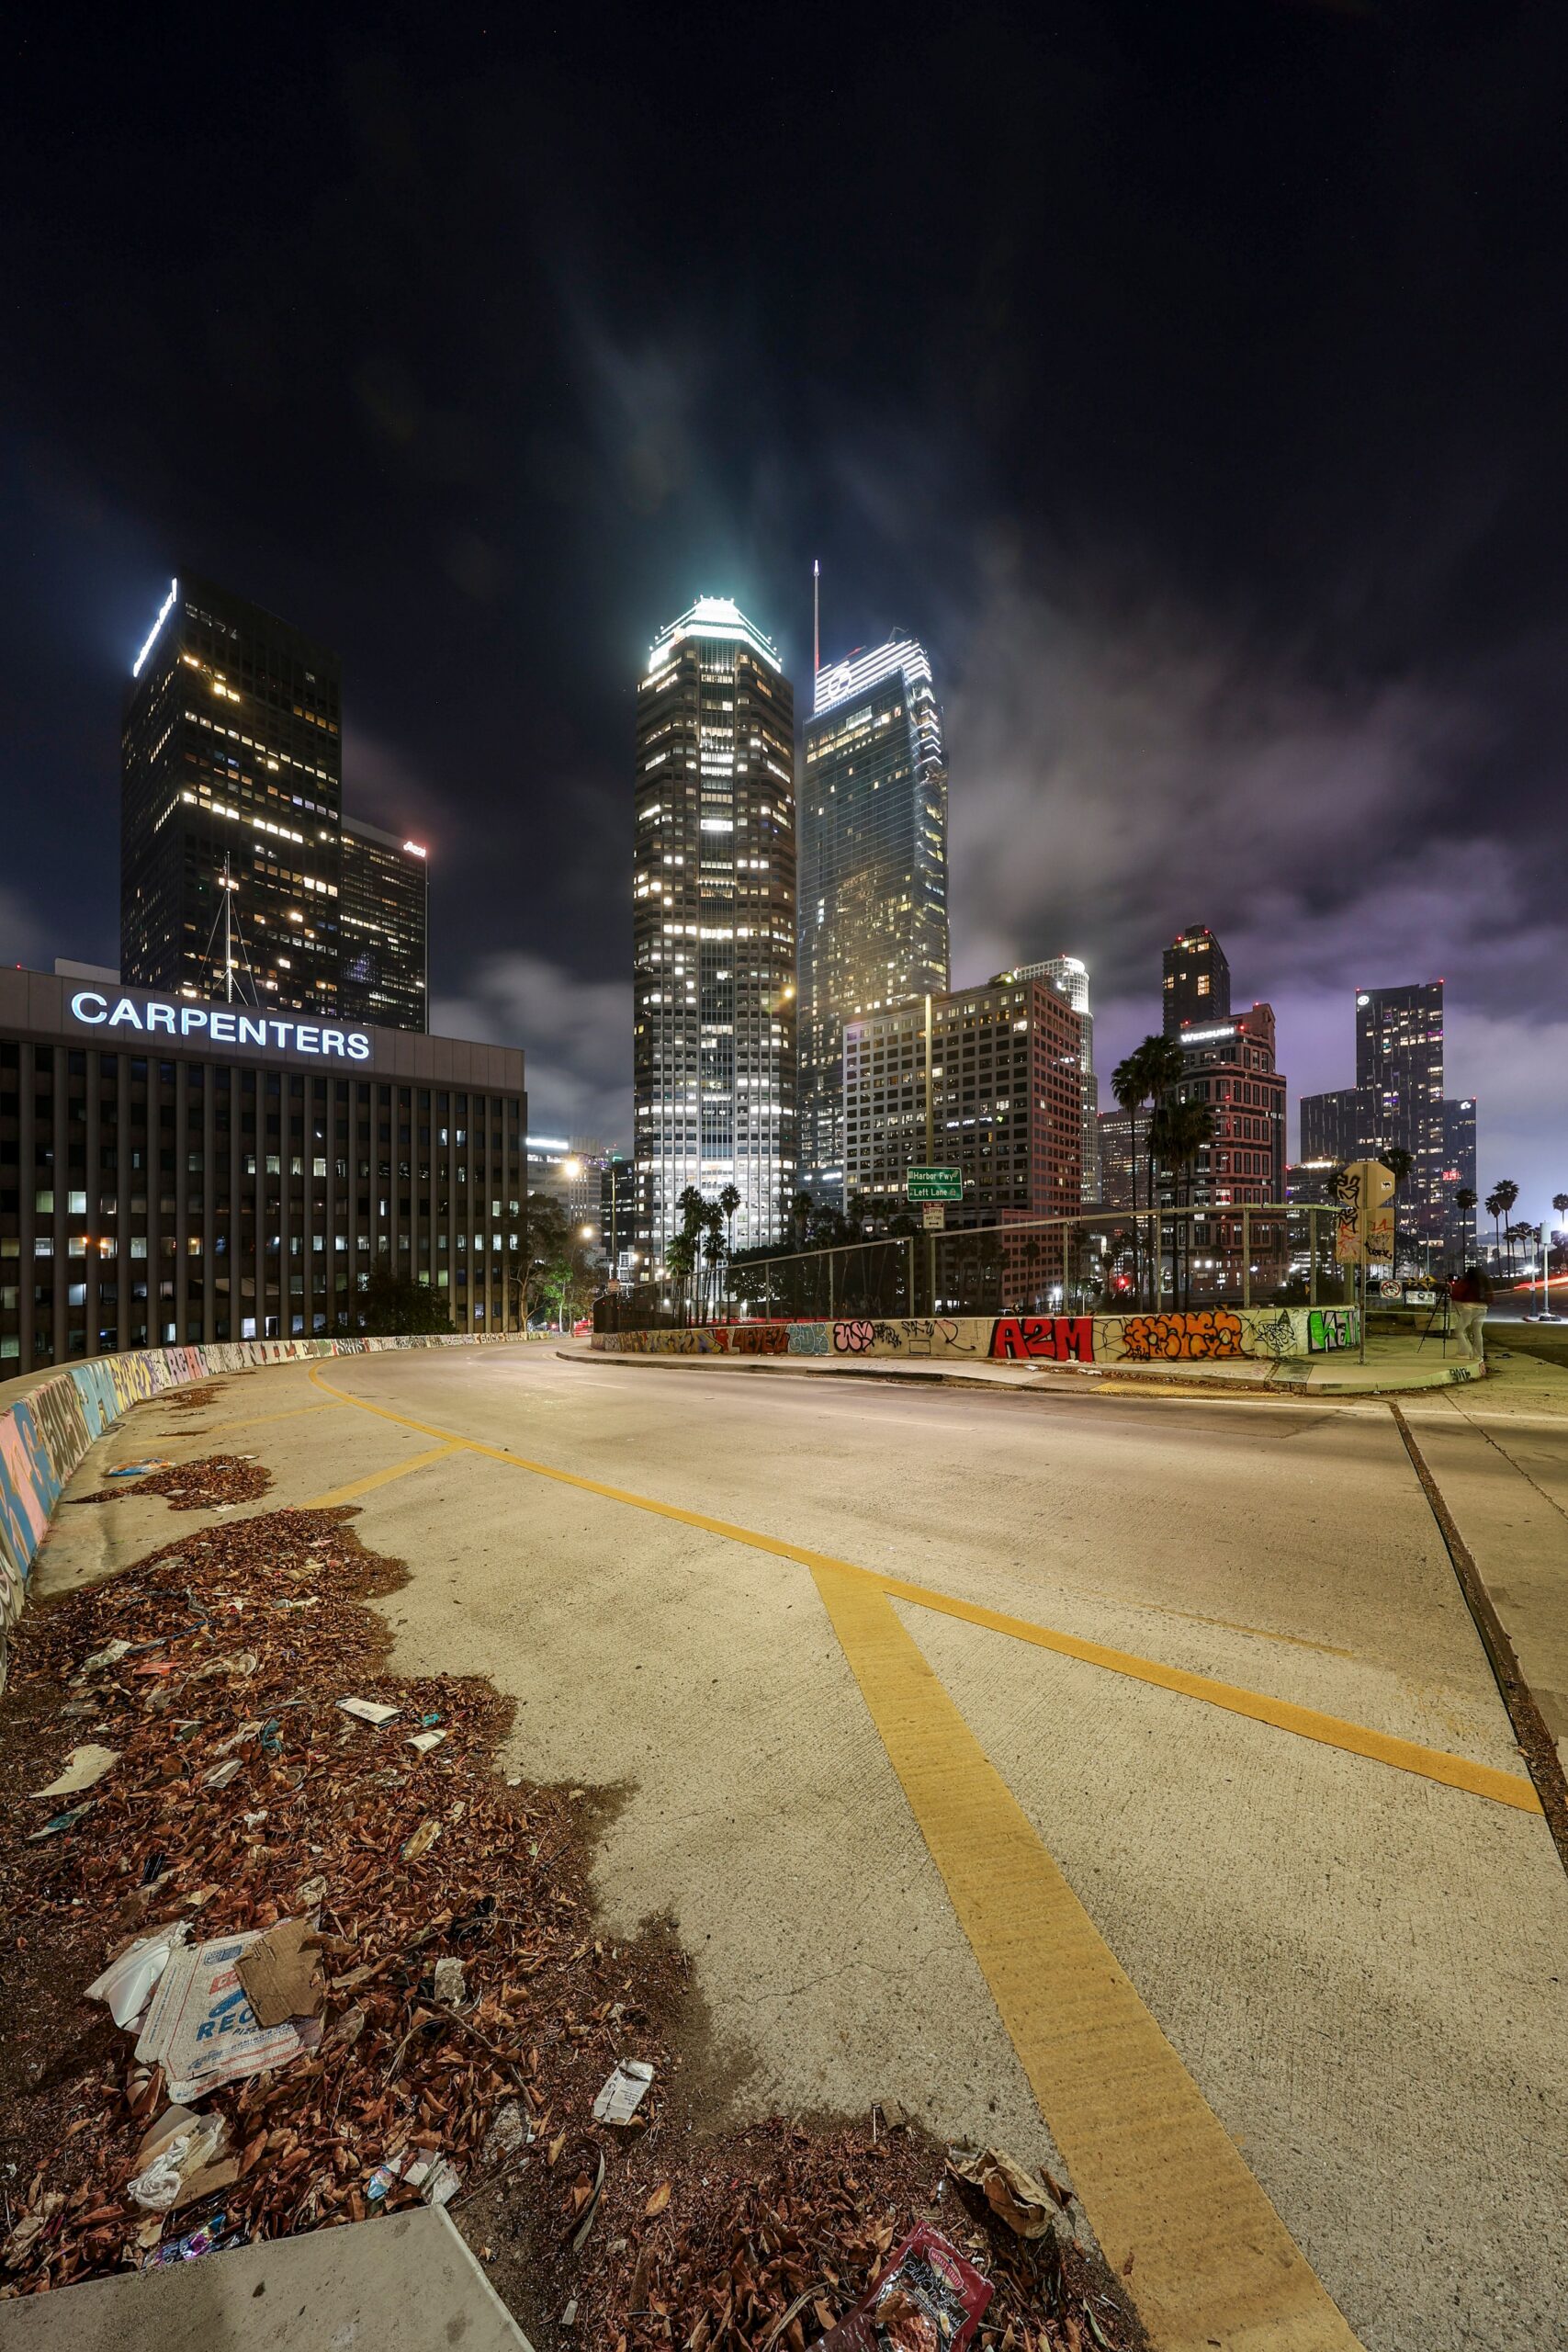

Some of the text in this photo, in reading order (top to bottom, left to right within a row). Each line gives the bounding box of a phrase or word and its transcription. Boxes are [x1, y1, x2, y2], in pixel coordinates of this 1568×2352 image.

[71, 992, 369, 1059] CARPENTERS
[913, 1171, 953, 1182] Harbor Fwy
[914, 1188, 948, 1196] Left Lane
[989, 1317, 1093, 1363] A2M
